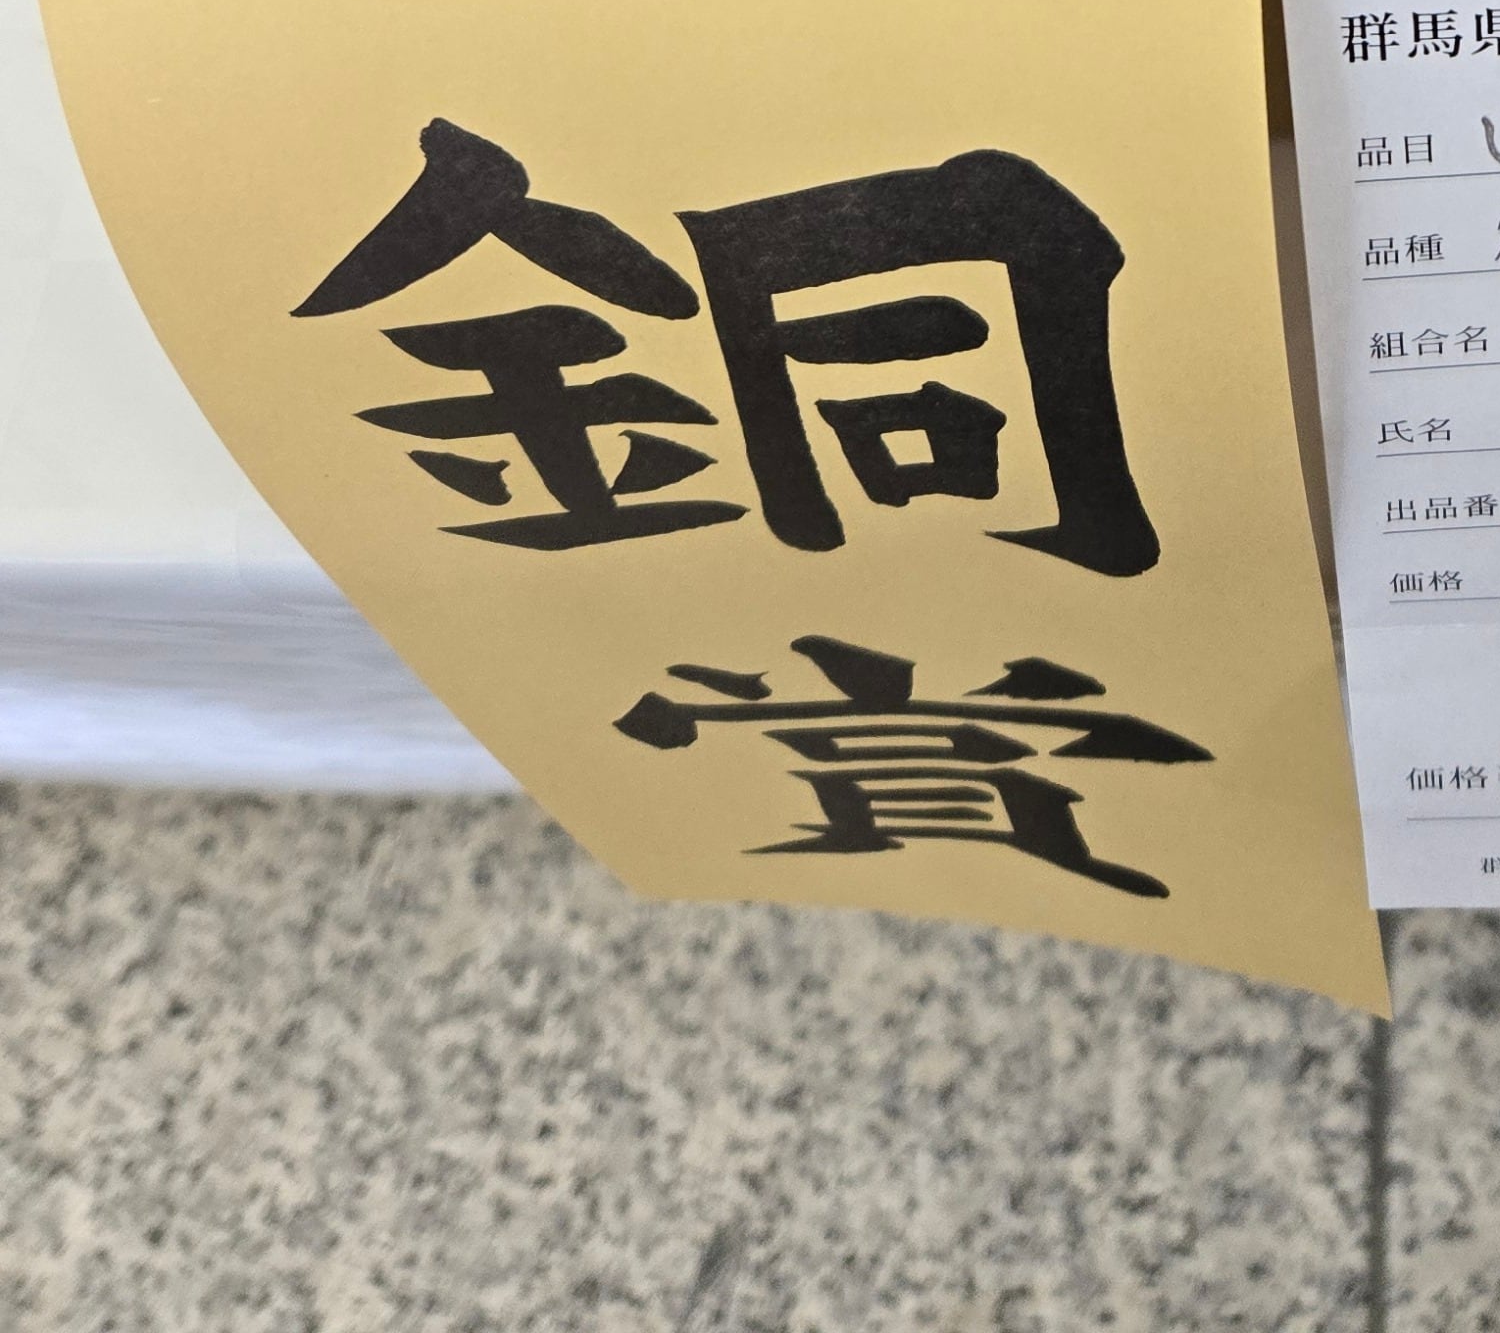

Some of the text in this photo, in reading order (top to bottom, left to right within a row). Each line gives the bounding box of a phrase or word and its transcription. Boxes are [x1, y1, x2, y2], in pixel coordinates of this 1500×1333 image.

[1356, 135, 1435, 167] 品目
[1363, 234, 1445, 267] 品種
[1369, 324, 1490, 360] 組合名
[1377, 417, 1453, 445] 氏名
[1389, 568, 1464, 595] 価格
